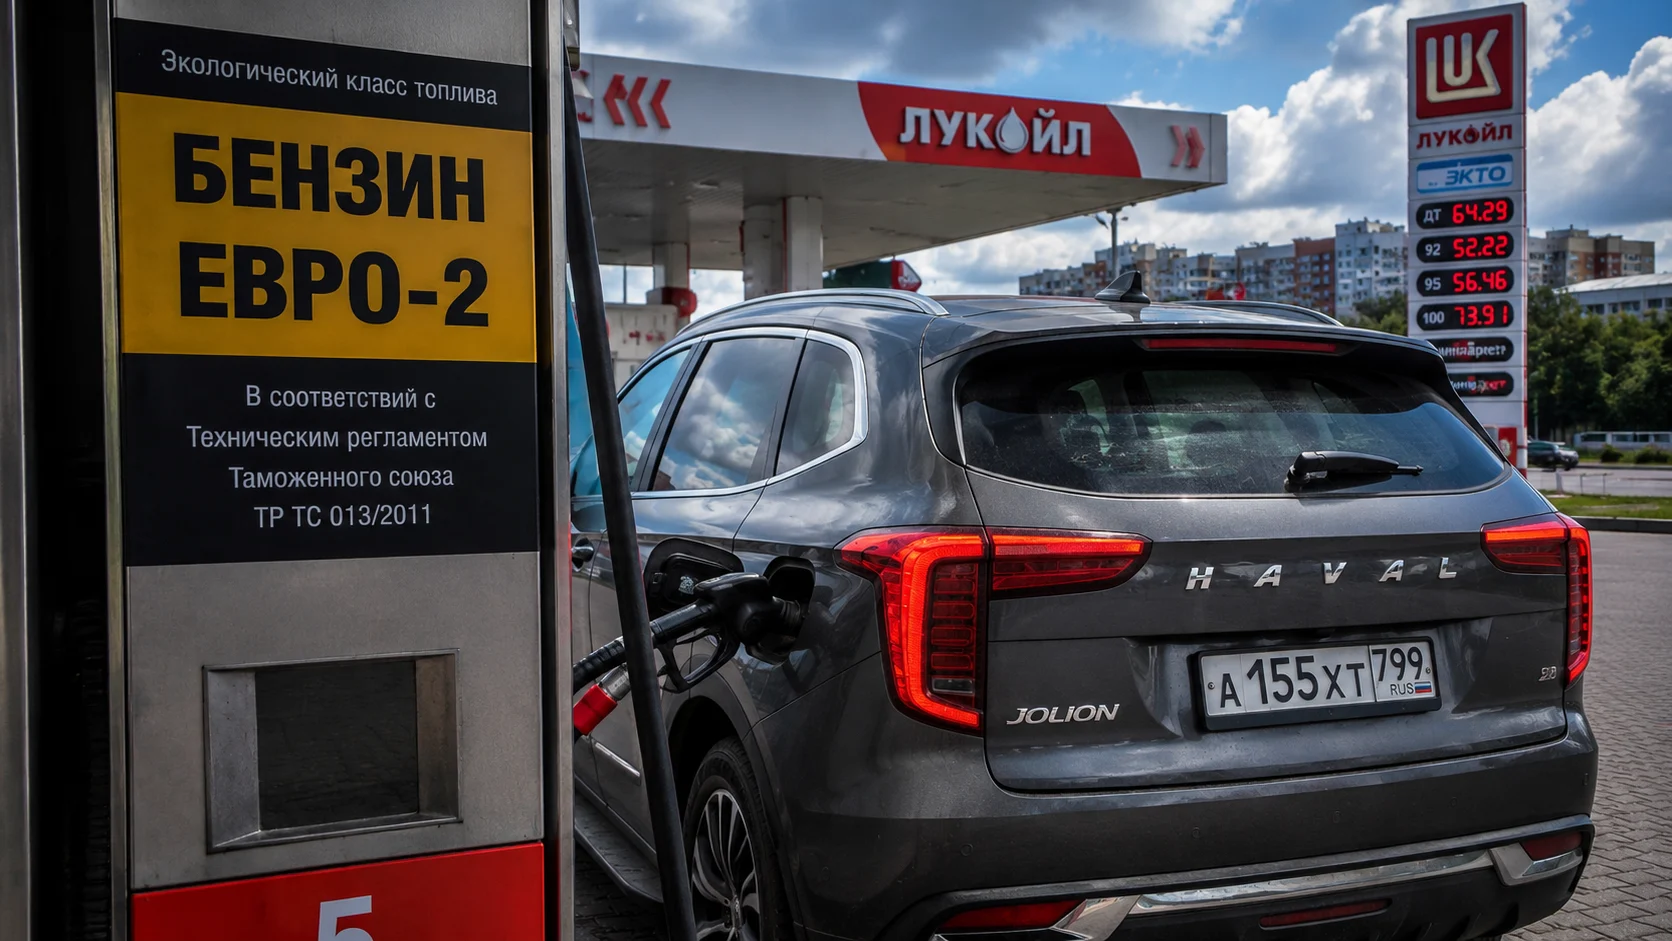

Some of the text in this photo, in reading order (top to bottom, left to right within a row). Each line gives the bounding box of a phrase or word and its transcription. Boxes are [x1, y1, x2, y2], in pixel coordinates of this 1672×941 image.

[160, 48, 498, 106] Экологический класс топлива
[900, 105, 1092, 155] ЛУКОЙЛ
[1416, 122, 1513, 150] ЛУКОЙЛ
[173, 132, 486, 223] БЕНЗИН
[1423, 200, 1508, 225] ДТ 64.29
[1424, 235, 1508, 258] 92 52.22
[179, 241, 489, 327] ЕВРО-2
[1424, 269, 1508, 292] 95 56.46
[1422, 304, 1508, 327] 100 73.91
[246, 384, 436, 408] В соответствий с
[186, 425, 488, 452] Техническим регламентом
[228, 466, 454, 488] Таможенного союза
[253, 503, 431, 528] ТР ТС 013/2011
[1185, 556, 1457, 591] HAVAL
[1371, 646, 1423, 682] 799
[1390, 682, 1415, 696] RUS
[1006, 703, 1120, 725] JOLION
[318, 894, 374, 941] 5
